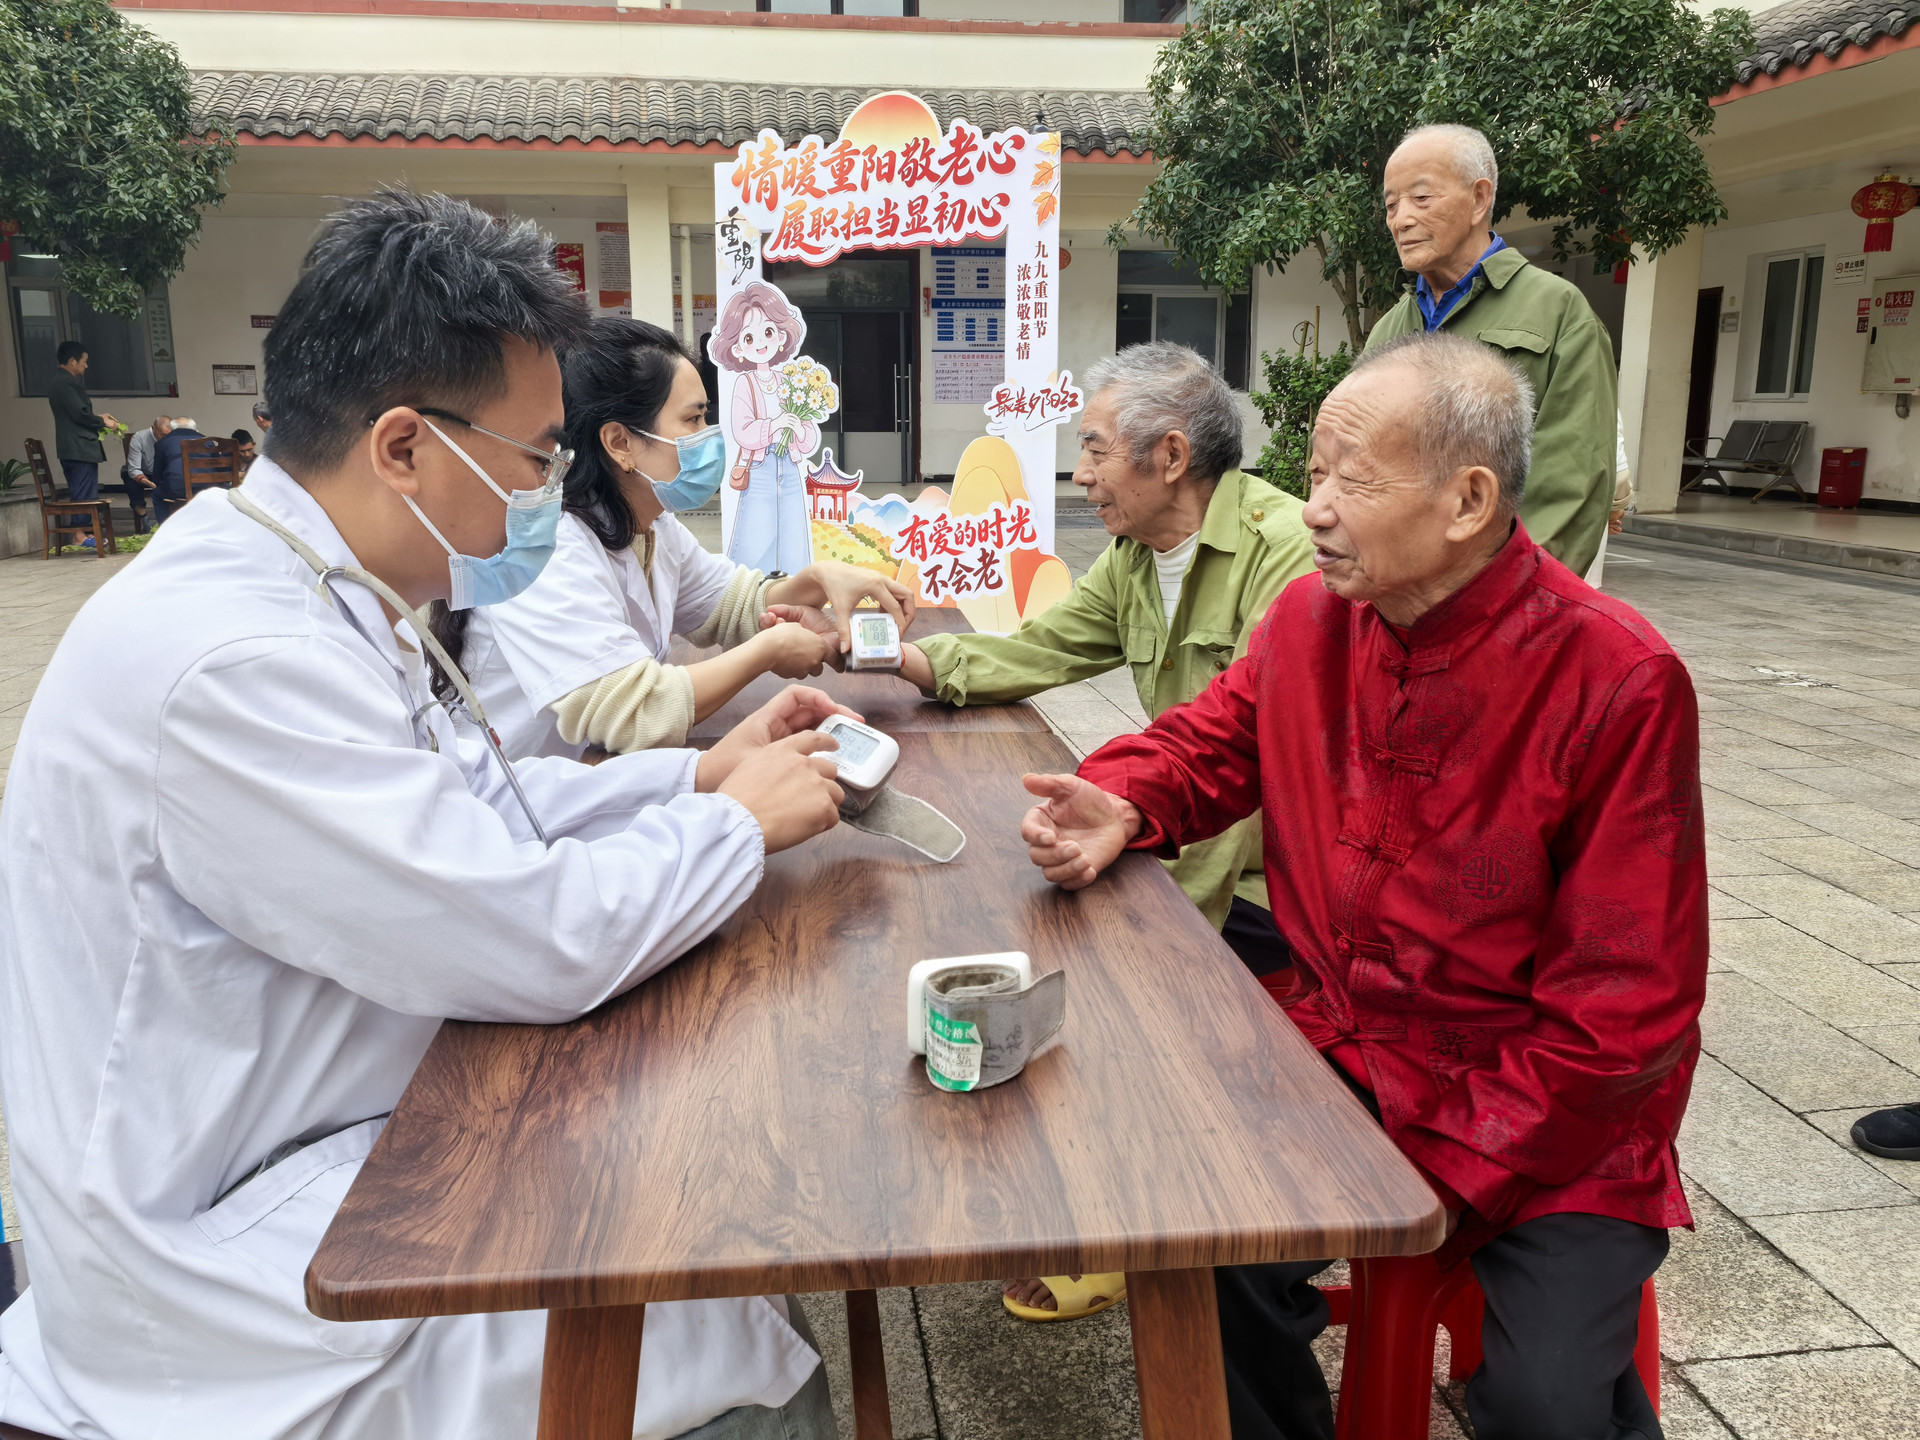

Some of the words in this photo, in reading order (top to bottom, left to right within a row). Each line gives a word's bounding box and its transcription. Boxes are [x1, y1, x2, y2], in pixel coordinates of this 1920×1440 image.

[732, 126, 1025, 211] 情暖重阳敬老心
[769, 192, 1010, 255] 履职担当显初心
[1016, 263, 1031, 360] 浓浓敬老情
[1034, 241, 1048, 338] 九九重阳节
[1885, 292, 1913, 306] 消火栓
[988, 376, 1079, 420] 最美夕阳红
[895, 504, 1037, 562] 有爱的时光
[923, 547, 1003, 598] 不会老
